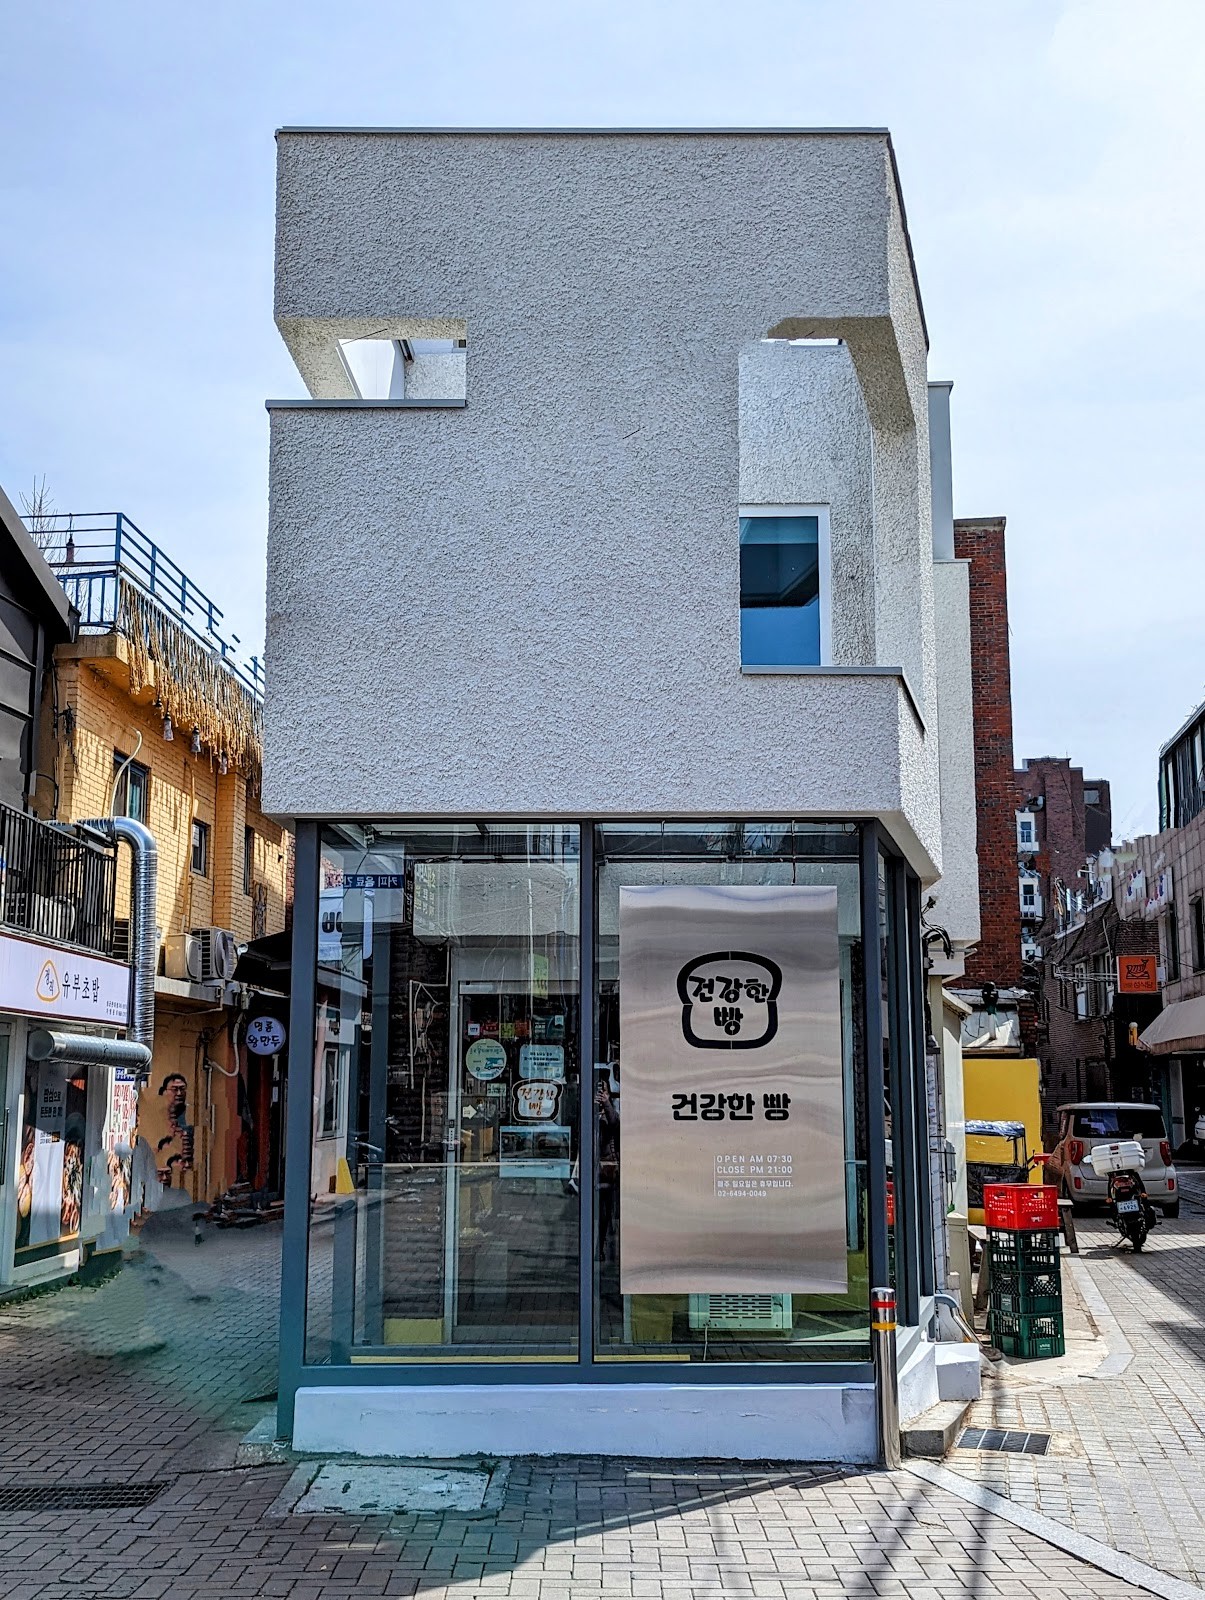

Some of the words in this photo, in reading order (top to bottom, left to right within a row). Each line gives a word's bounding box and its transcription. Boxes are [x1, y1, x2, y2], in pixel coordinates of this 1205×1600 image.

[62, 971, 100, 1003] 유부초밥
[688, 975, 770, 1004] 건강한
[713, 1006, 744, 1036] 빵
[248, 1034, 281, 1048] 왕만두
[671, 1092, 755, 1122] 건강한
[762, 1092, 791, 1122] 빵
[716, 1155, 745, 1163] OPEN
[749, 1155, 764, 1163] AM
[716, 1165, 745, 1174] CLOSE
[750, 1165, 764, 1174] PM
[767, 1165, 793, 1174] 21:00
[732, 1180, 757, 1188] 일요일은
[760, 1180, 794, 1188] 휴무입니다.
